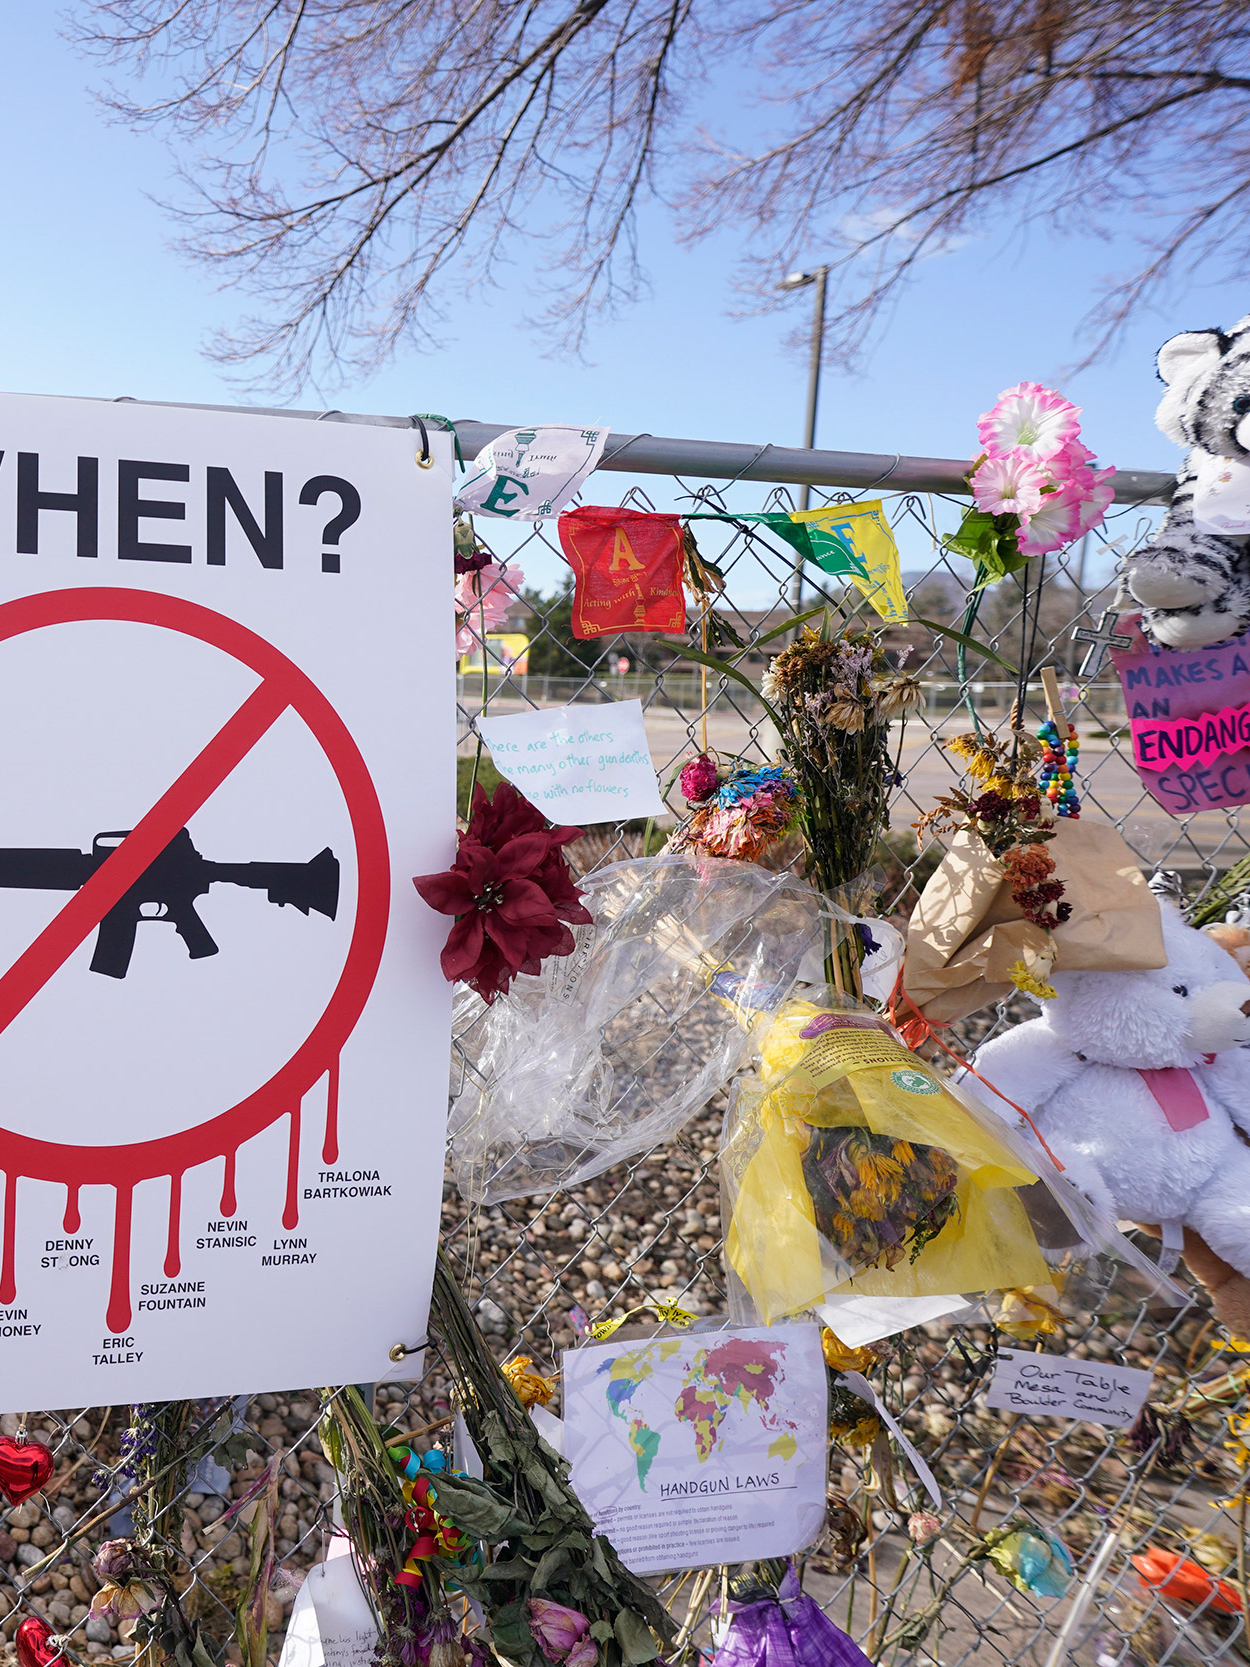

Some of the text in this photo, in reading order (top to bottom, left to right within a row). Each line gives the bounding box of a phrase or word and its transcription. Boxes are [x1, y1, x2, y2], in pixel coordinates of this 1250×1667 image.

[609, 527, 646, 571] A
[815, 550, 836, 561] ance
[584, 599, 611, 609] Acting
[614, 588, 636, 604] with
[1126, 658, 1223, 690] MAKES
[1132, 697, 1170, 719] AN
[527, 741, 547, 752] are
[550, 732, 574, 746] the
[578, 730, 614, 744] others
[1137, 711, 1250, 762] ENDANG
[517, 761, 557, 776] many
[558, 753, 592, 770] other
[544, 784, 568, 800] with
[585, 779, 629, 798] flowers
[318, 1170, 380, 1183] TRALONA
[303, 1185, 392, 1200] BARTKOWIAK
[207, 1220, 248, 1233] NEVIN
[45, 1238, 94, 1252] DENNY
[196, 1235, 257, 1250] STANISIC
[273, 1238, 307, 1250] LYNN
[40, 1254, 100, 1269] STONG
[261, 1253, 317, 1266] MURRAY
[140, 1281, 205, 1296] SUZANNE
[138, 1297, 206, 1312] FOUNTAIN
[102, 1336, 135, 1349] ERIC
[92, 1351, 144, 1365] TALLEY
[1020, 1364, 1131, 1395] Our Table
[1014, 1379, 1114, 1403] Mesa and
[1004, 1392, 1134, 1423] Boulder Community
[660, 1472, 780, 1497] HANDGUN LAWS
